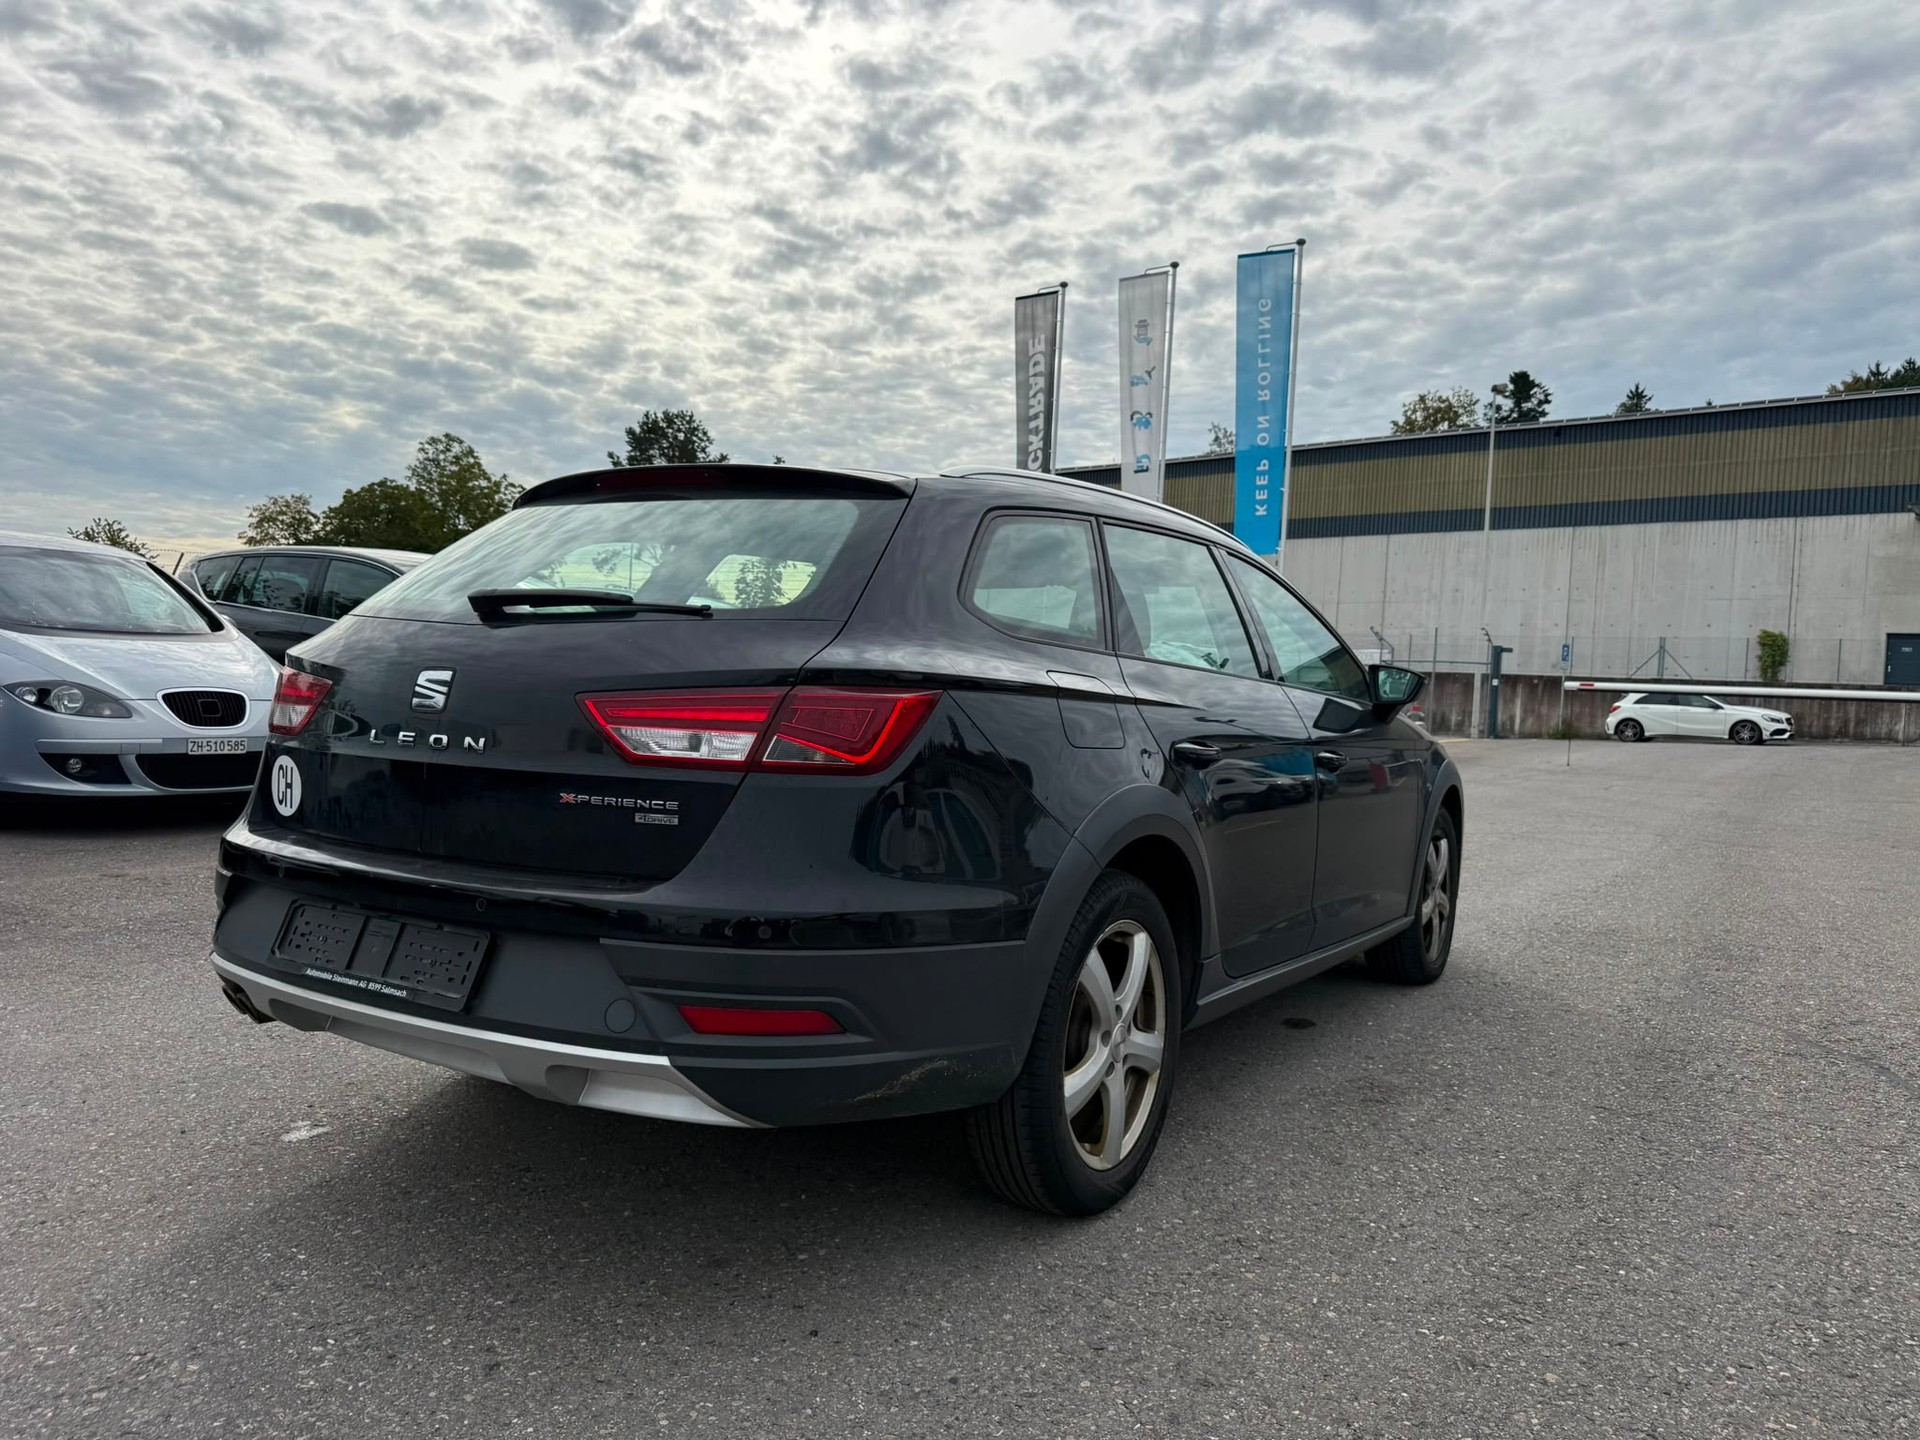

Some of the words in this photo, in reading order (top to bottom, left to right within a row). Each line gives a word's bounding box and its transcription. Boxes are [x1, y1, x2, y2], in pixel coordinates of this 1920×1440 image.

[370, 729, 486, 753] LEON
[277, 764, 294, 809] CH
[559, 793, 679, 810] XPERIENCE
[637, 814, 678, 824] 4DRIVE
[305, 968, 333, 980] Automobile
[358, 980, 367, 989] AG
[368, 982, 382, 992] 8599
